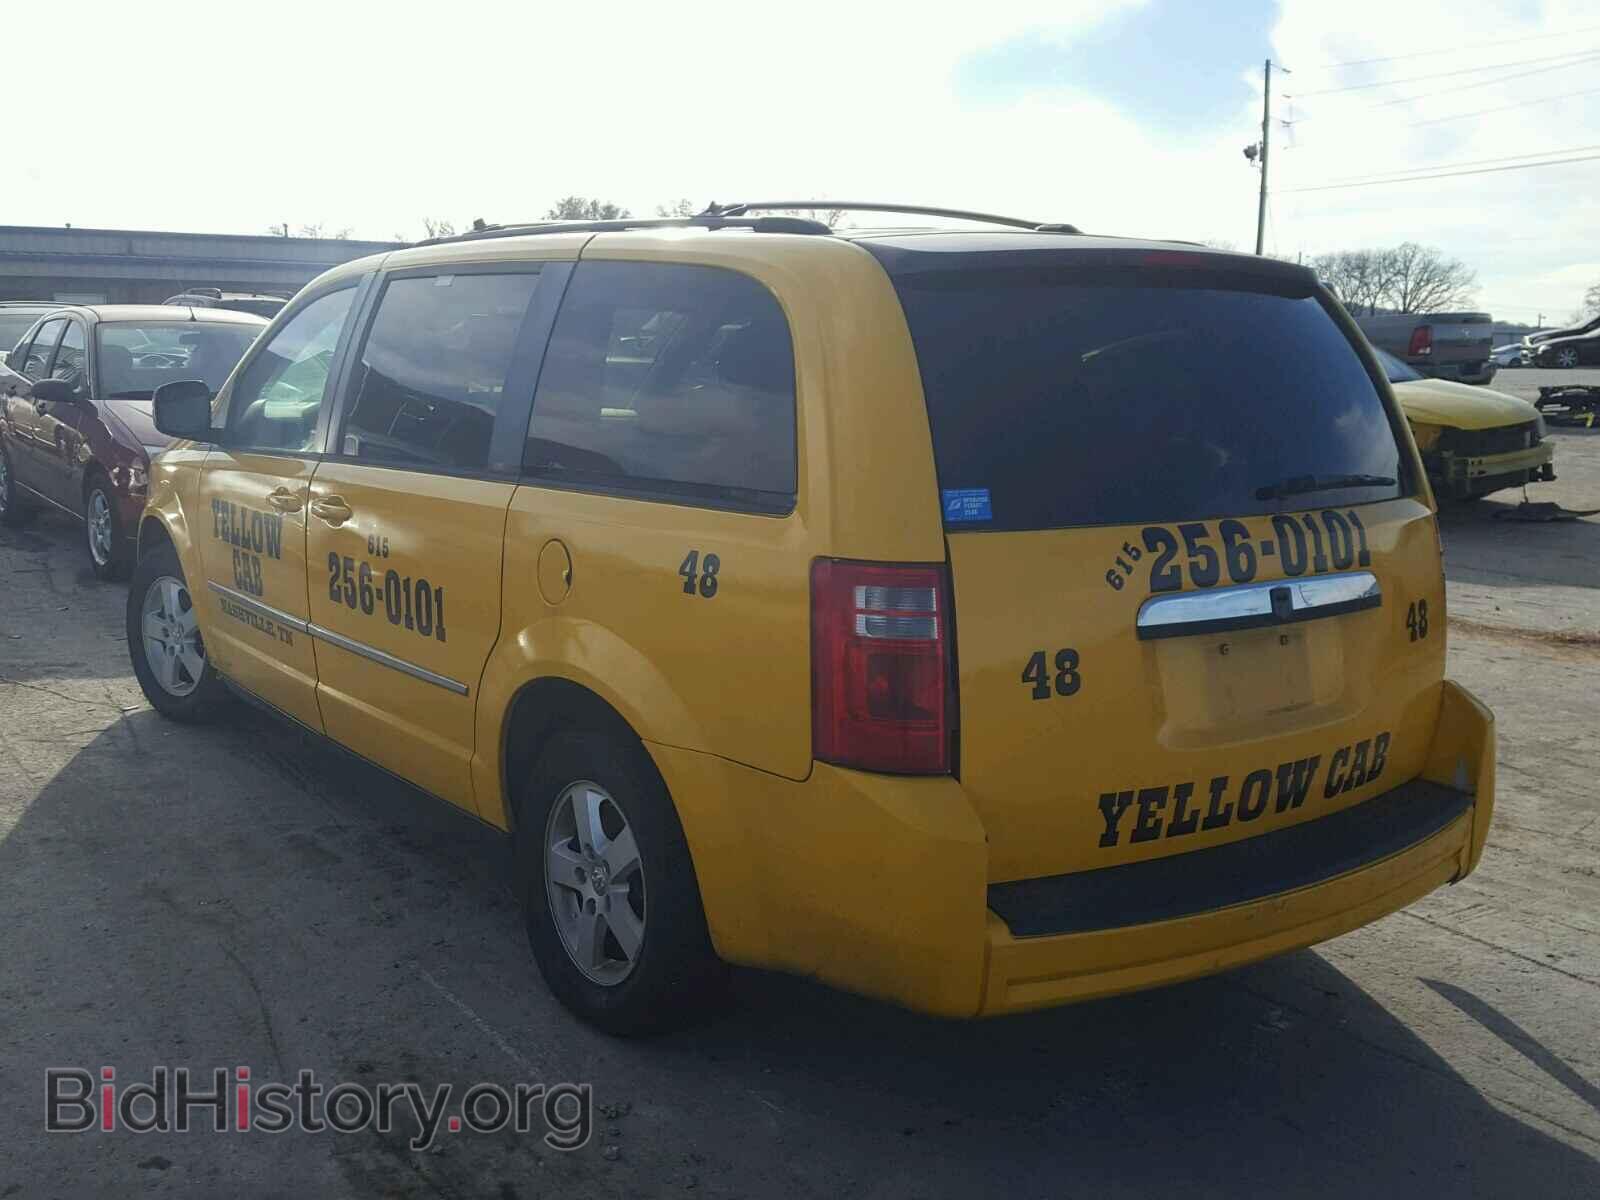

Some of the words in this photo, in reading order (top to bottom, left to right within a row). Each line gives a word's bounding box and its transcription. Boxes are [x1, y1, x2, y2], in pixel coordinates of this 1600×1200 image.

[211, 498, 283, 560] YELLOW
[368, 534, 389, 559] 615
[1105, 541, 1142, 591] 615
[1141, 509, 1371, 593] 256-0101
[232, 547, 264, 597] CAB
[327, 551, 447, 643] 256-0101
[678, 550, 721, 599] 48
[1406, 598, 1429, 643] 48
[1021, 648, 1081, 701] 48
[1097, 754, 1321, 849] YELLOW
[1323, 731, 1391, 799] CAB
